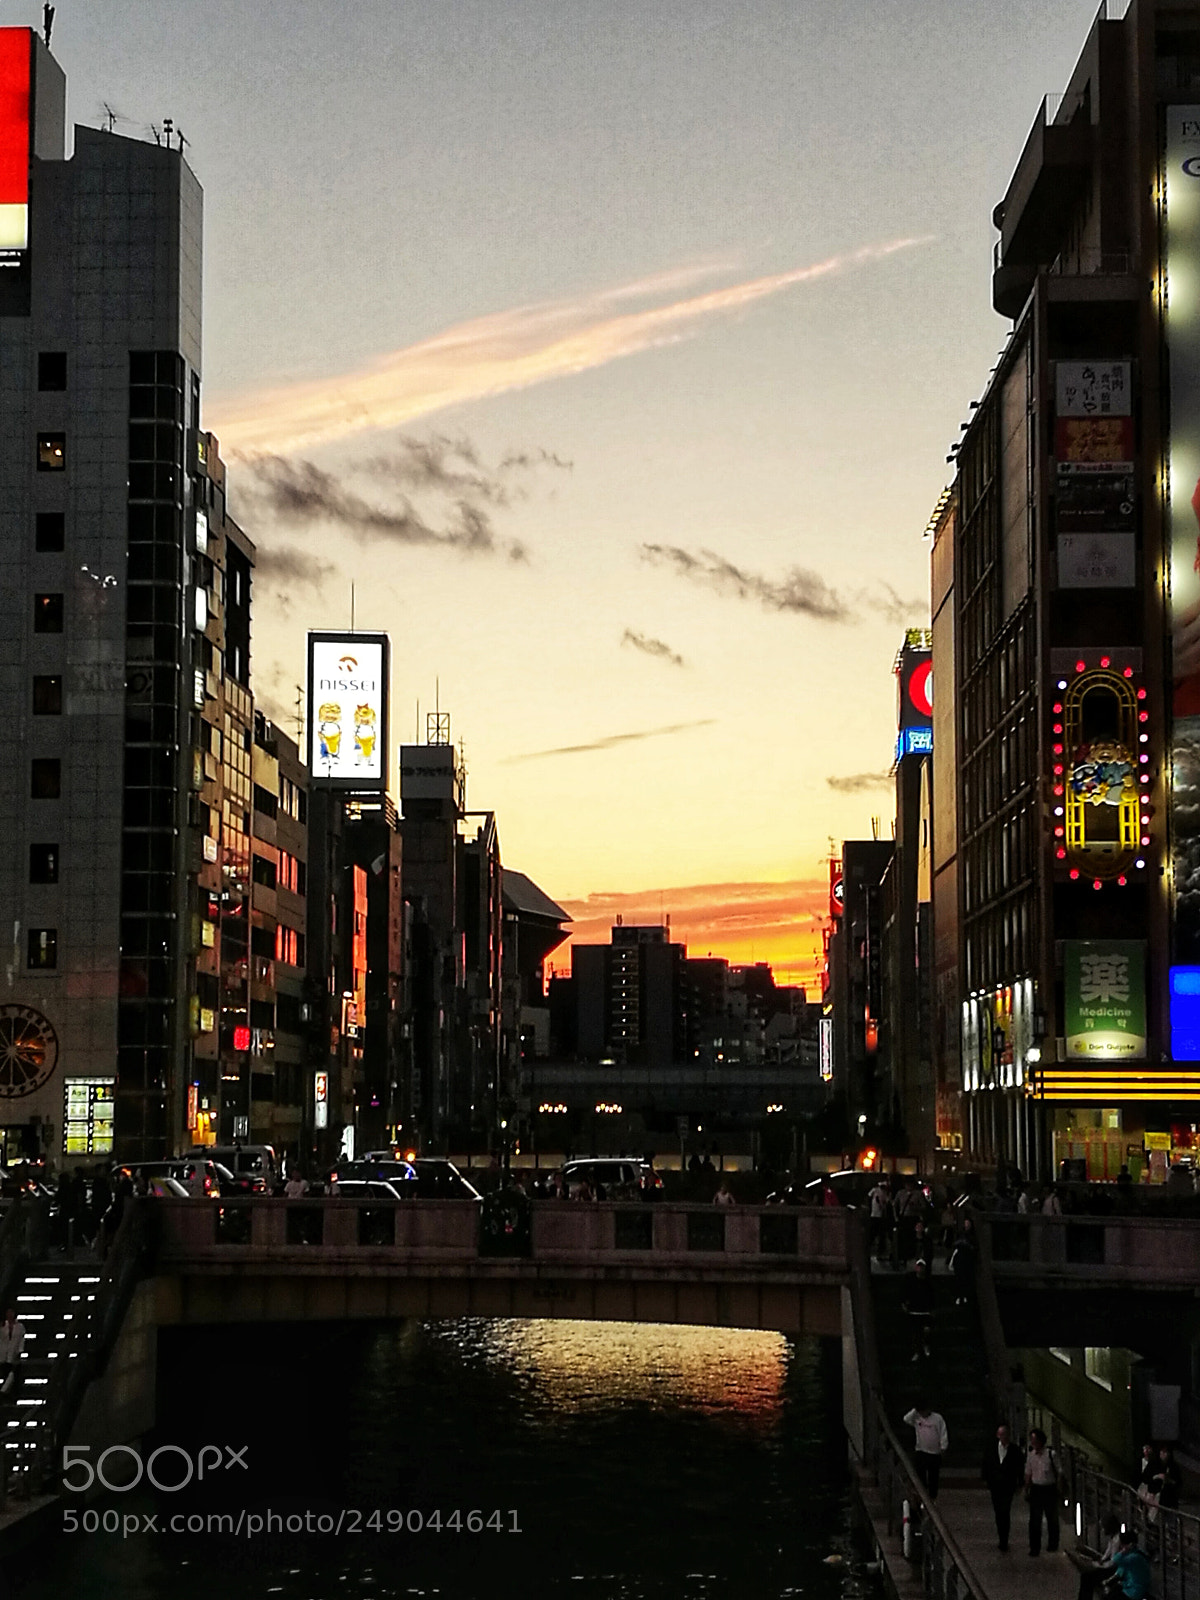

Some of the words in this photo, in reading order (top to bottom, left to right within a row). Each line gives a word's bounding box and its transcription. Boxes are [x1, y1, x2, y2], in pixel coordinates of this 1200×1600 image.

[320, 679, 376, 692] NISSEI
[1079, 954, 1131, 1003] 薬
[1078, 1007, 1132, 1017] Medicine
[1088, 1043, 1105, 1051] Don
